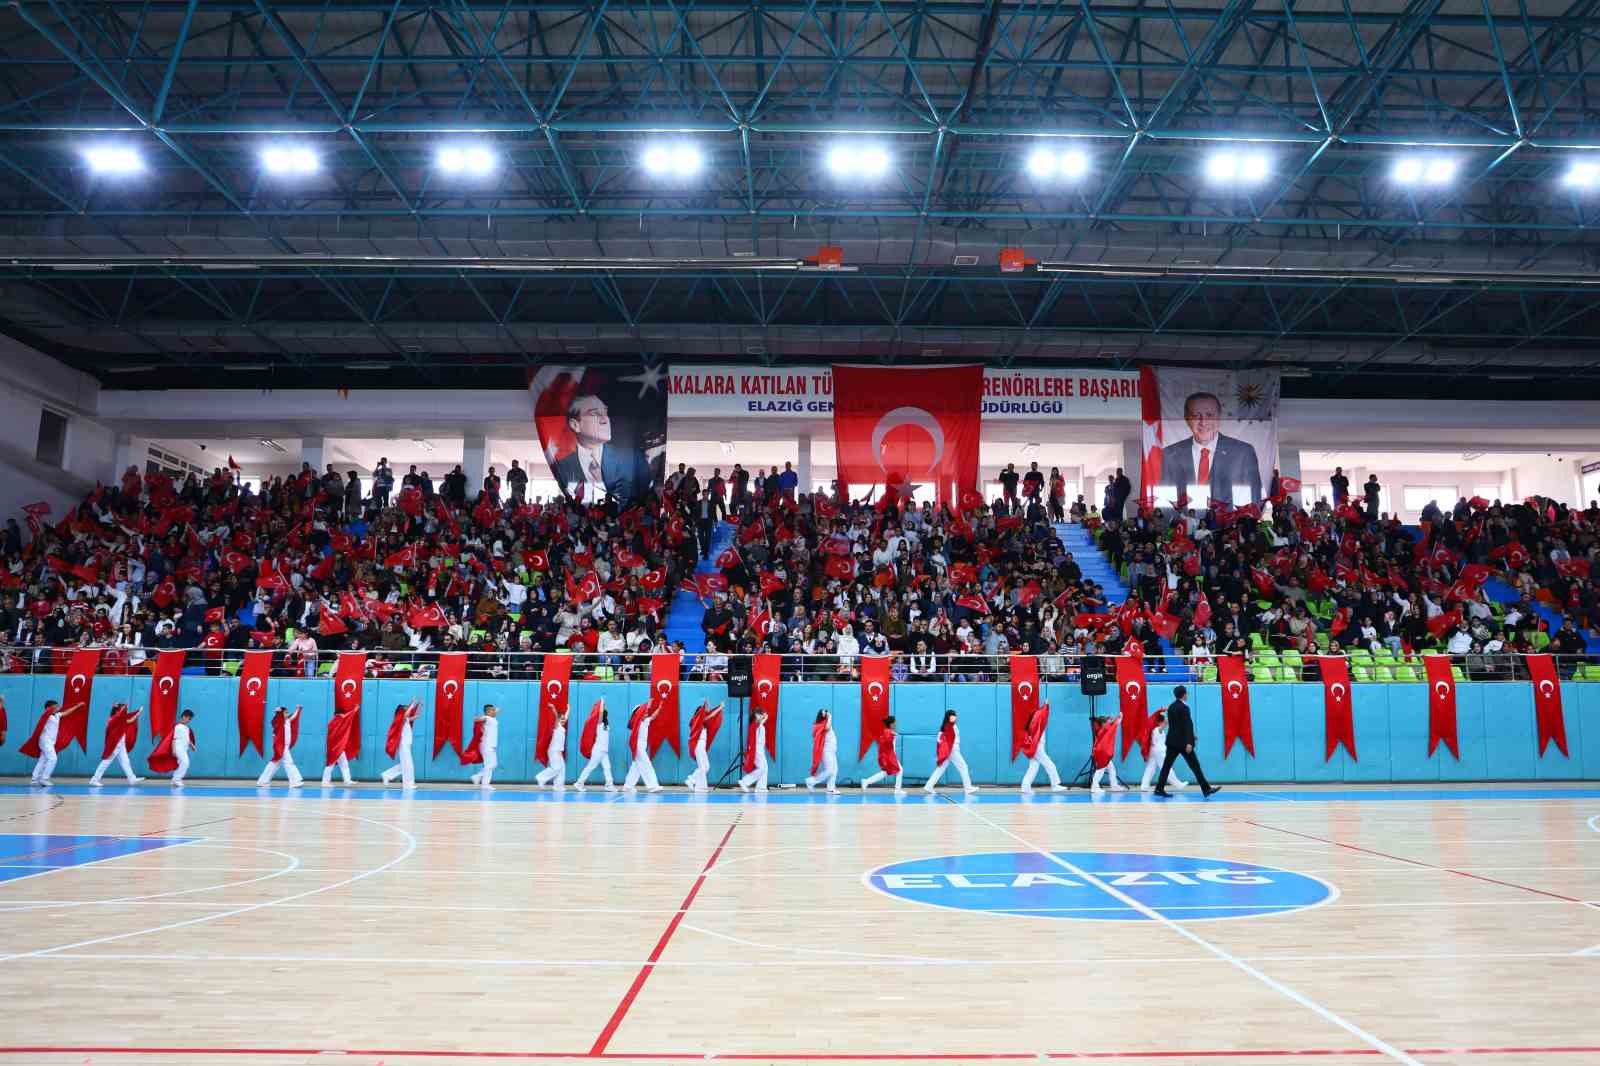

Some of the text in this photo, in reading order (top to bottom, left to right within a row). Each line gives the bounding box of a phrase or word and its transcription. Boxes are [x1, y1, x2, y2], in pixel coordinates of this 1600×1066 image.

[741, 376, 806, 395] KATILAN
[812, 371, 832, 395] TÜ
[748, 400, 803, 412] ELAZIĞ
[881, 868, 1275, 889] ELAZIĞ
